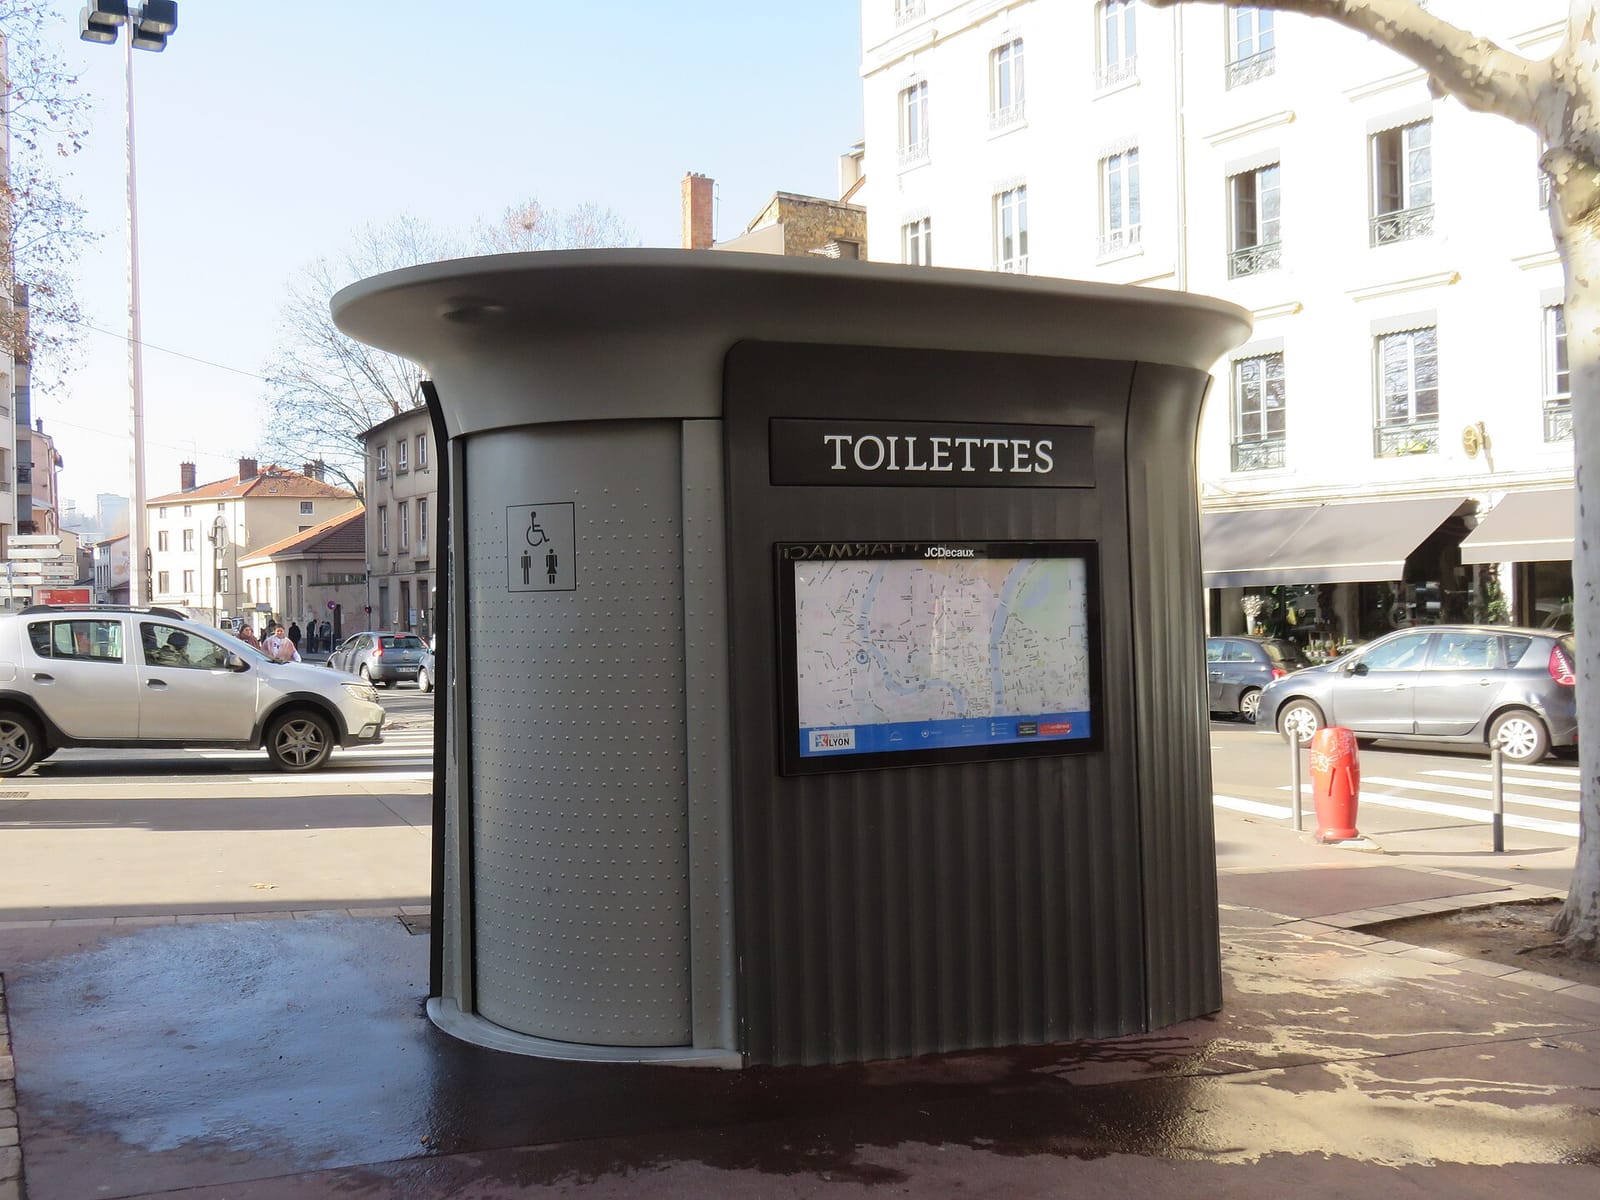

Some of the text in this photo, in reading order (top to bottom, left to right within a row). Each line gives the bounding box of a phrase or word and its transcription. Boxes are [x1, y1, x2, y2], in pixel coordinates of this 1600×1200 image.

[824, 435, 1054, 473] TOILETTES
[924, 547, 974, 558] JCDecaux
[829, 738, 850, 747] LYON
